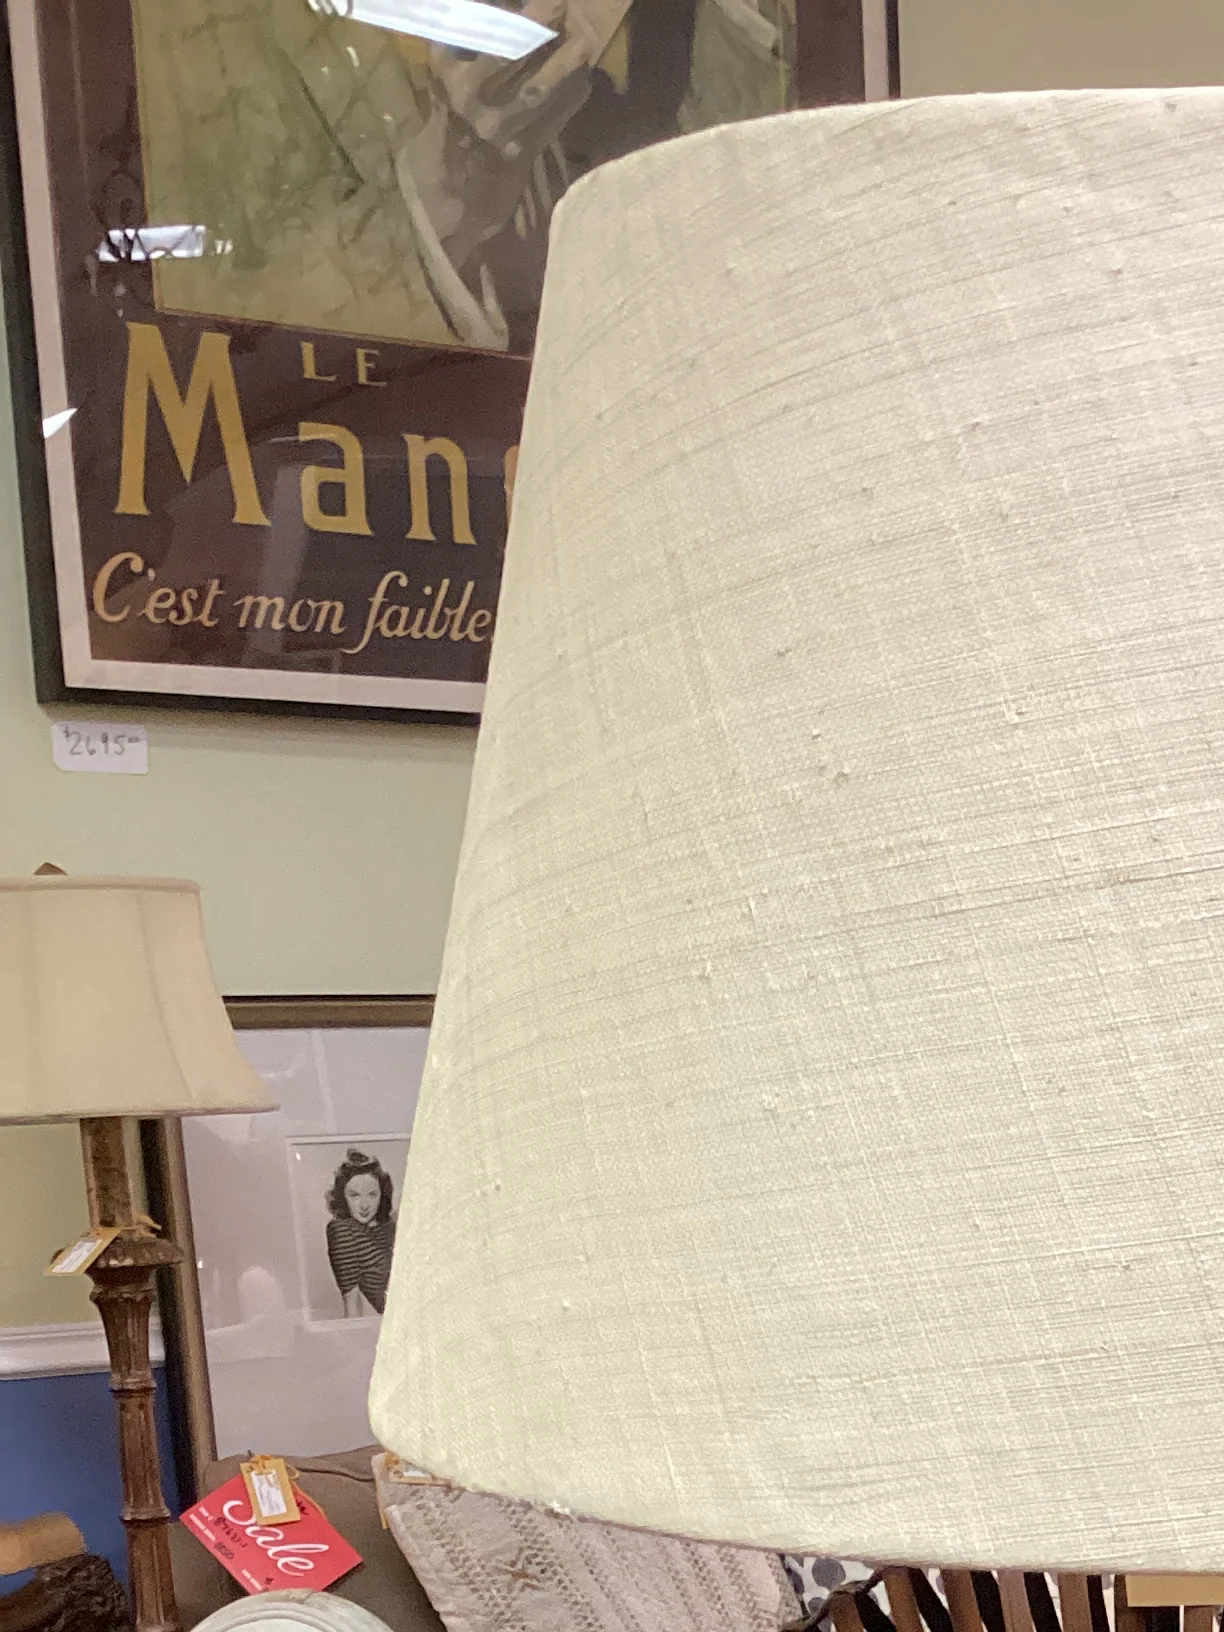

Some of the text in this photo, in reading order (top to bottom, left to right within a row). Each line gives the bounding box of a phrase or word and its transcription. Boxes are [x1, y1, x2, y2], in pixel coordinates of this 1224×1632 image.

[299, 341, 388, 388] LE
[114, 322, 524, 546] Man
[93, 551, 224, 629] C'est
[234, 593, 348, 635] mon
